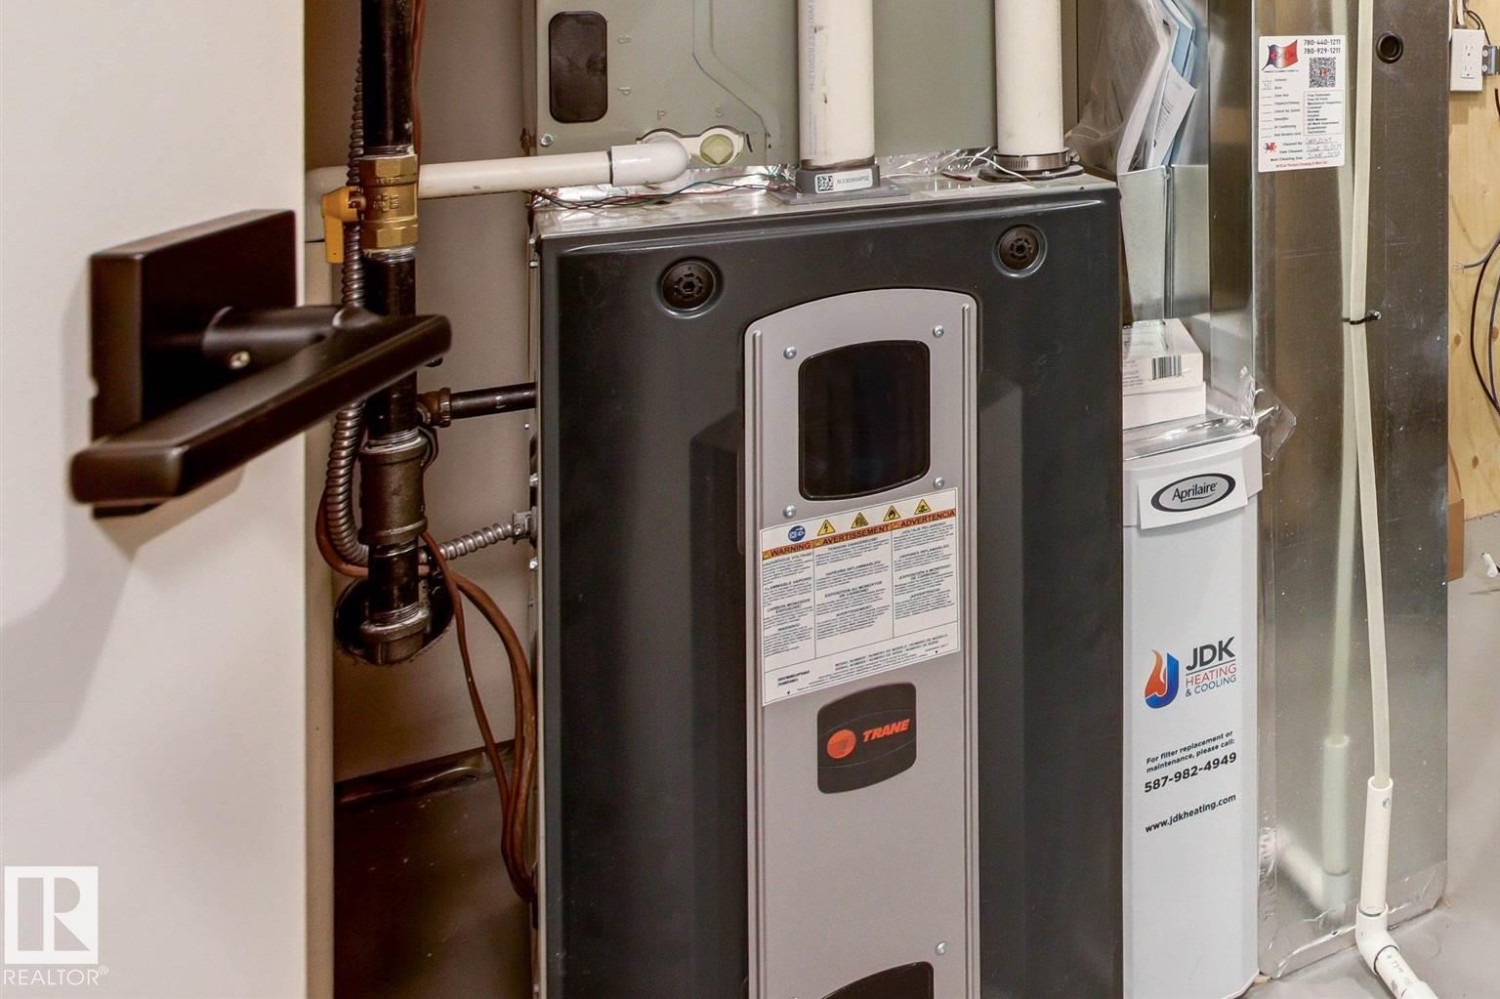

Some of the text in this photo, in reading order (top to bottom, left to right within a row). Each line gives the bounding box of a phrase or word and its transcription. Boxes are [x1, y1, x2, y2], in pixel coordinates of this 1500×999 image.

[770, 510, 956, 557] WARNING AVERTISSEMENT ADVERTENCIA
[1186, 636, 1235, 671] JDK
[1185, 663, 1237, 687] HEATING
[1185, 674, 1237, 697] & COOLING
[862, 718, 910, 743] TRANE
[1146, 756, 1159, 764] For
[1160, 750, 1178, 760] filter
[1180, 733, 1224, 753] replacement
[1146, 738, 1235, 773] maintenance, please call:
[1144, 752, 1237, 793] 587-982-4949
[1145, 794, 1236, 833] www.jdkheating.com
